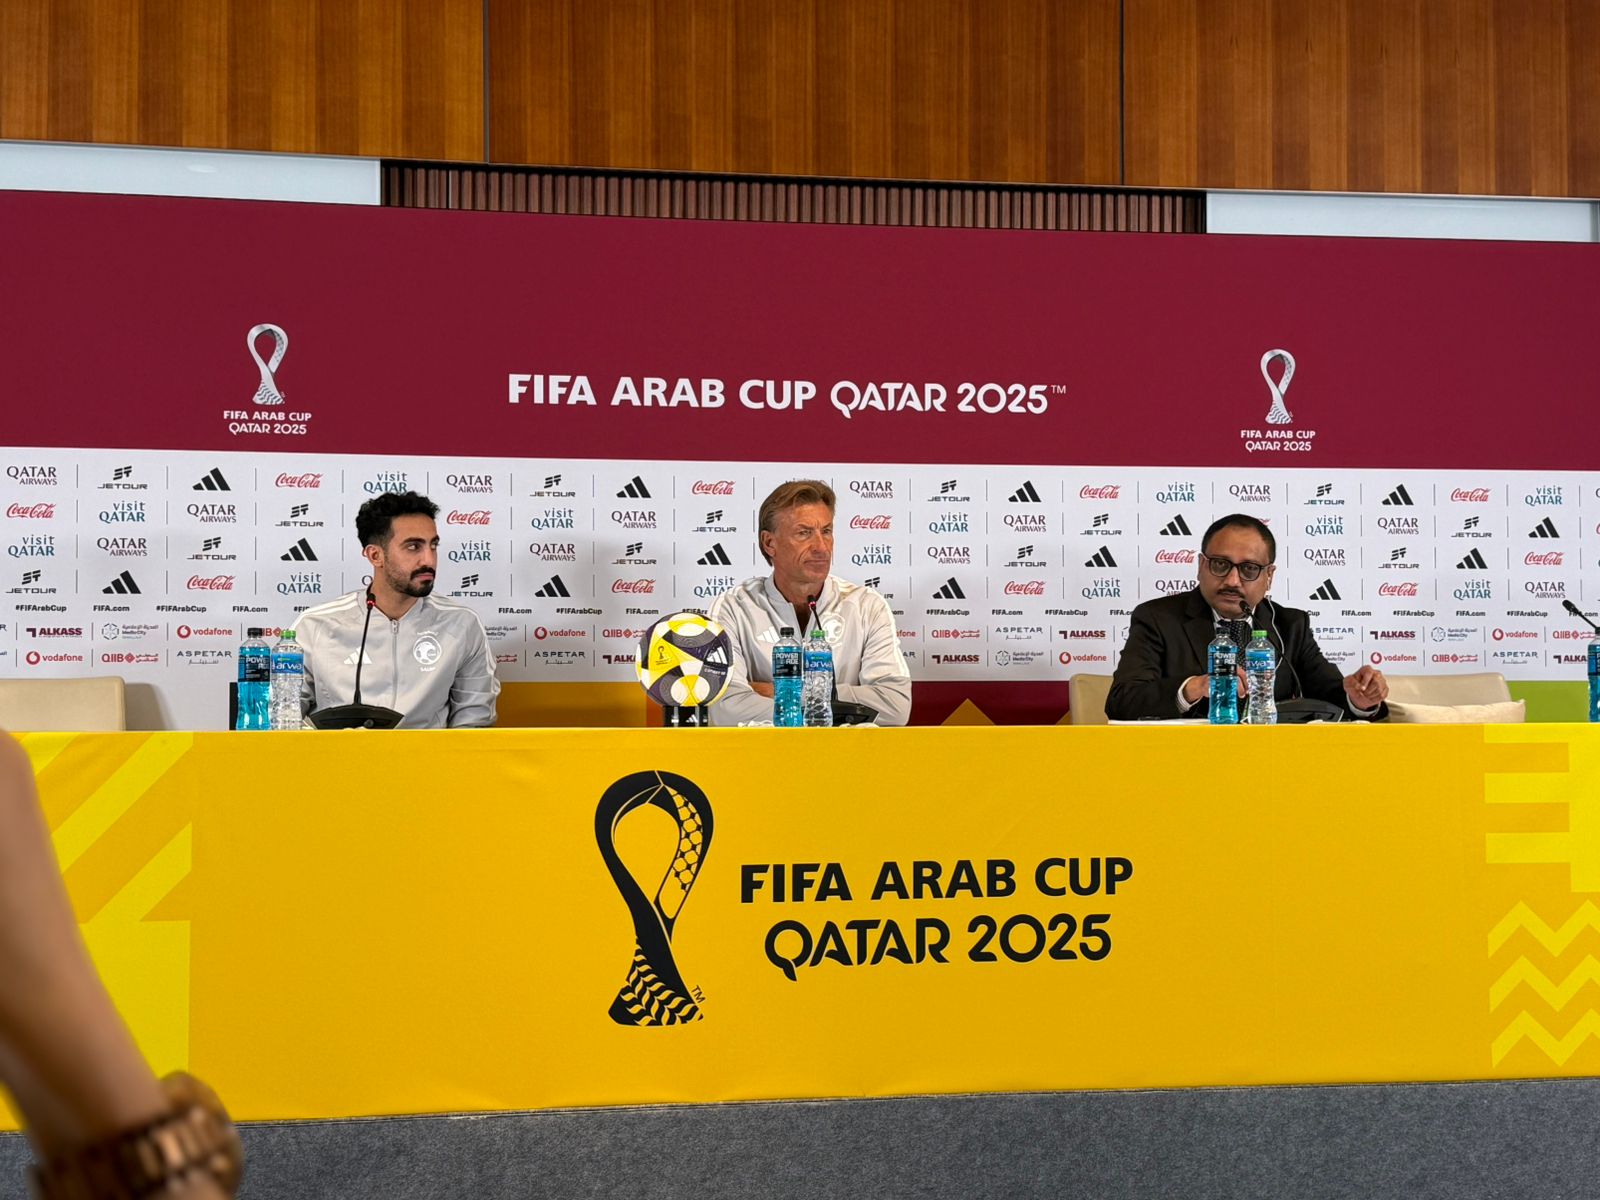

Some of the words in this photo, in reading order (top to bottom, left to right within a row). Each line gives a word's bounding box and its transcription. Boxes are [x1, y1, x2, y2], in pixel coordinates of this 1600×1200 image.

[509, 374, 597, 405] FIFA
[611, 377, 725, 407] ARAB
[739, 380, 816, 409] CUP
[831, 381, 947, 418] QATAR
[957, 383, 1047, 414] 2025
[224, 411, 248, 419] FIFA
[252, 411, 285, 420] ARAB
[289, 412, 312, 421] CUP
[229, 422, 270, 435] QATAR
[274, 423, 306, 434] 2025
[1241, 430, 1262, 438] FIFA
[1265, 430, 1293, 438] ARAB
[1296, 431, 1315, 439] CUP
[1245, 441, 1281, 452] QATAR
[1283, 441, 1311, 451] 2025
[7, 466, 56, 479] QATAR
[377, 471, 407, 481] visit
[446, 475, 492, 488] QATAR
[850, 481, 892, 493] QATAR
[1168, 482, 1194, 492] visit
[1229, 485, 1270, 497] QATAR
[1536, 485, 1562, 495] visit
[1156, 492, 1194, 503] QATAR
[1525, 495, 1562, 506] QATAR
[113, 501, 145, 511] visit
[187, 504, 236, 517] QATAR
[99, 511, 145, 524] QATAR
[544, 508, 573, 518] visit
[611, 511, 656, 523] QATAR
[941, 512, 968, 522] visit
[532, 518, 573, 530] QATAR
[1004, 515, 1045, 527] QATAR
[1317, 515, 1343, 524] visit
[1378, 518, 1418, 529] QATAR
[929, 522, 968, 534] QATAR
[1305, 525, 1343, 536] QATAR
[23, 534, 55, 545] visit
[97, 538, 147, 551] QATAR
[461, 540, 491, 550] visit
[8, 545, 54, 558] QATAR
[530, 543, 575, 556] QATAR
[864, 544, 891, 554] visit
[928, 547, 970, 559] QATAR
[448, 551, 490, 563] QATAR
[852, 554, 891, 566] QATAR
[1304, 549, 1345, 561] QATAR
[291, 572, 321, 582] visit
[706, 576, 734, 586] visit
[1094, 578, 1120, 587] visit
[277, 583, 321, 595] QATAR
[1155, 579, 1197, 592] QATAR
[1465, 579, 1490, 589] visit
[1525, 582, 1565, 594] QATAR
[1082, 588, 1120, 599] QATAR
[1454, 589, 1491, 600] QATAR
[39, 628, 82, 636] ALKASS
[1070, 630, 1106, 638] ALKASS
[1380, 631, 1415, 640] ALKASS
[741, 863, 853, 903] FIFA
[871, 859, 1016, 900] ARAB
[1035, 857, 1133, 896] CUP
[765, 918, 950, 981] QATAR
[968, 913, 1111, 963] 2025
